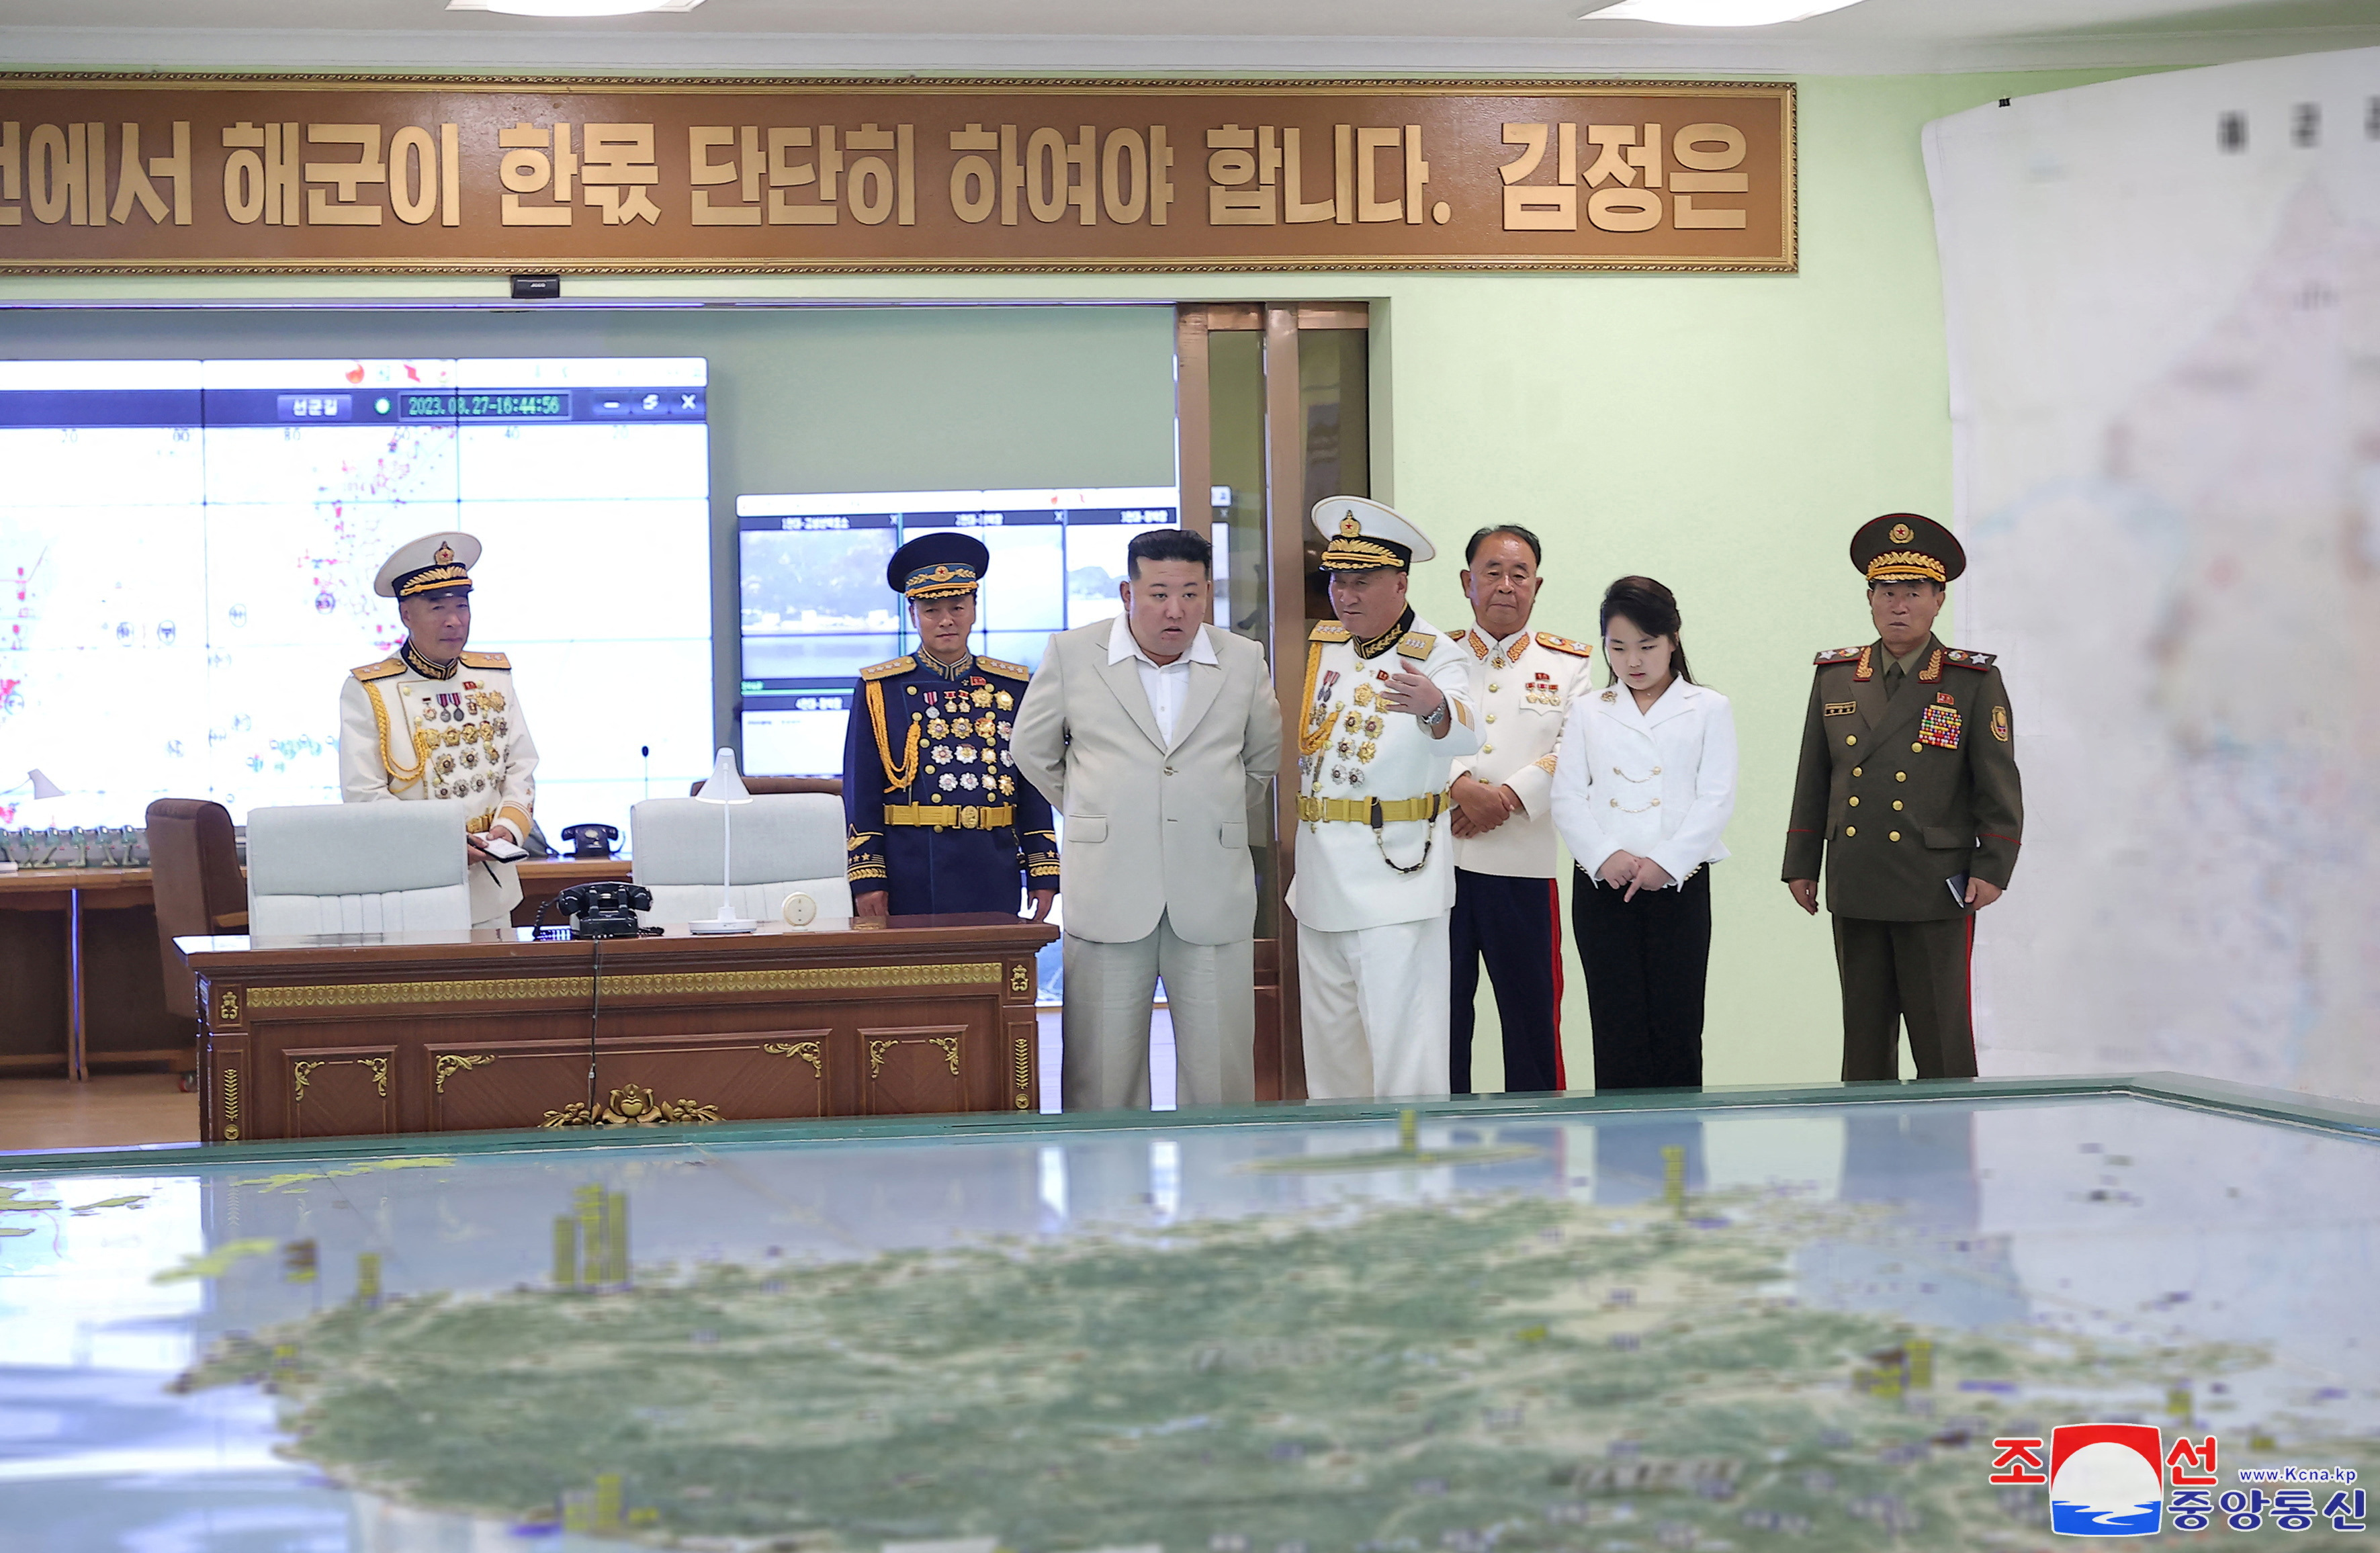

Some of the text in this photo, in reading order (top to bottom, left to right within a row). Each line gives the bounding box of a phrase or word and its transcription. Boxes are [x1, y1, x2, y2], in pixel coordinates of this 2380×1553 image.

[222, 122, 460, 227] 해군이
[498, 122, 662, 227] 한몫
[689, 123, 916, 226] 단단히
[950, 124, 1174, 226] 하여야
[1207, 123, 1452, 226] 합니다.
[1498, 122, 1749, 232] 김정은
